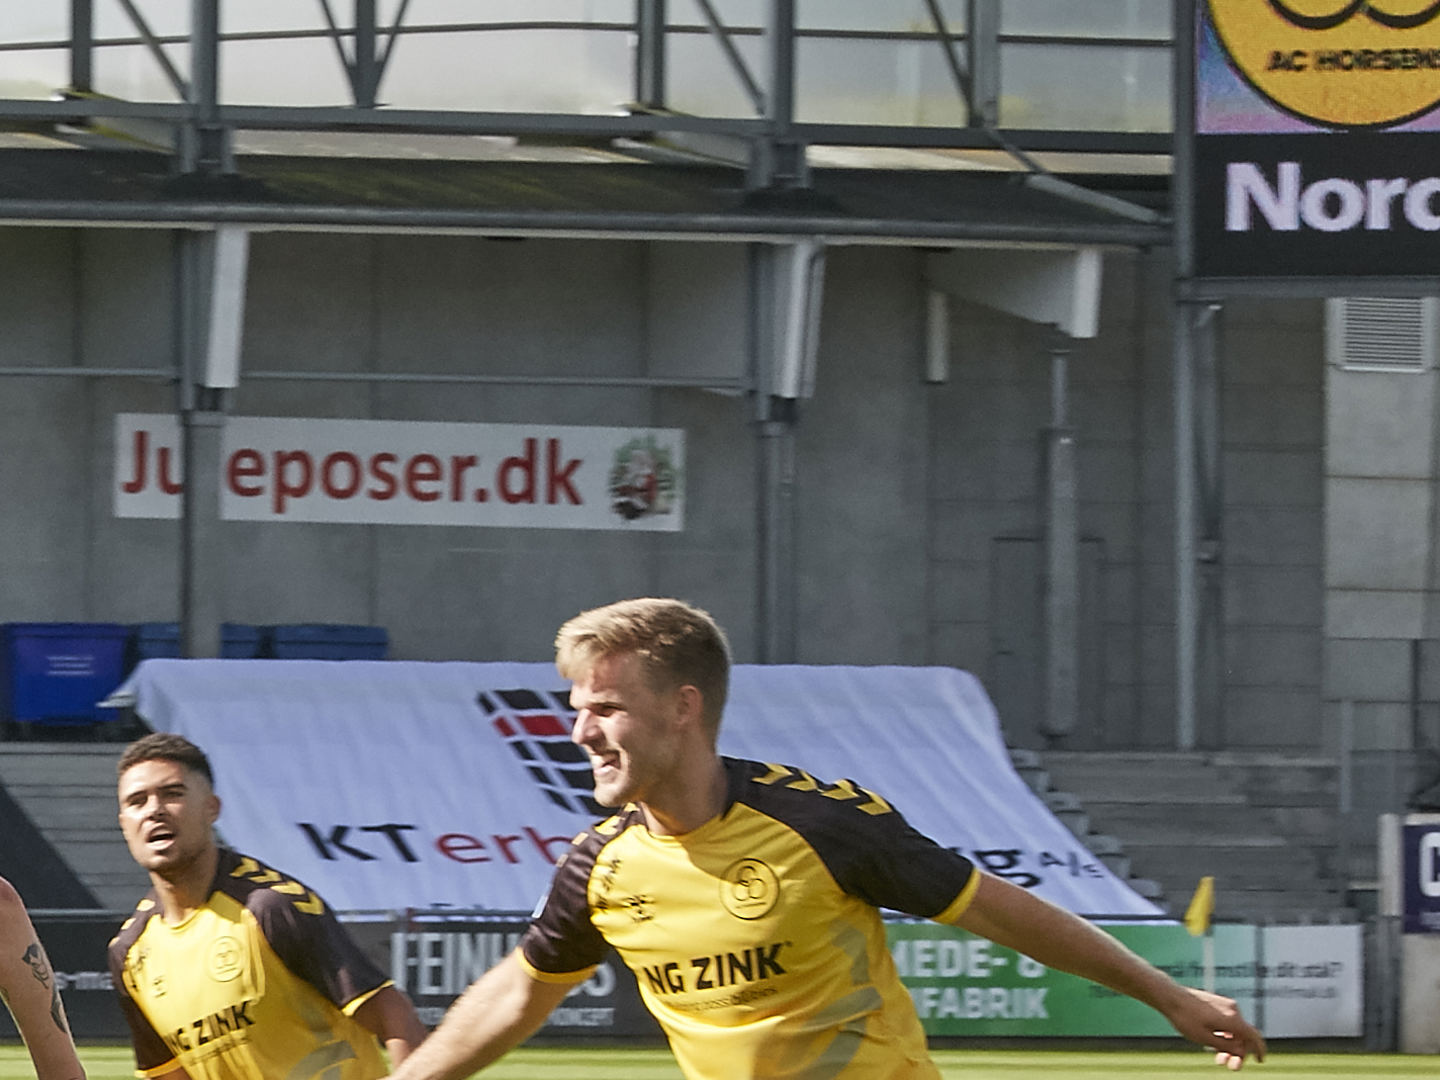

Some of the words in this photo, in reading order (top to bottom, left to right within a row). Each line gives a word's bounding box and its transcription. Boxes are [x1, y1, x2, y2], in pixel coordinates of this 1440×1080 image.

[1267, 50, 1307, 71] AC
[122, 430, 585, 514] Jueposer.dk
[691, 941, 788, 991] ZINK
